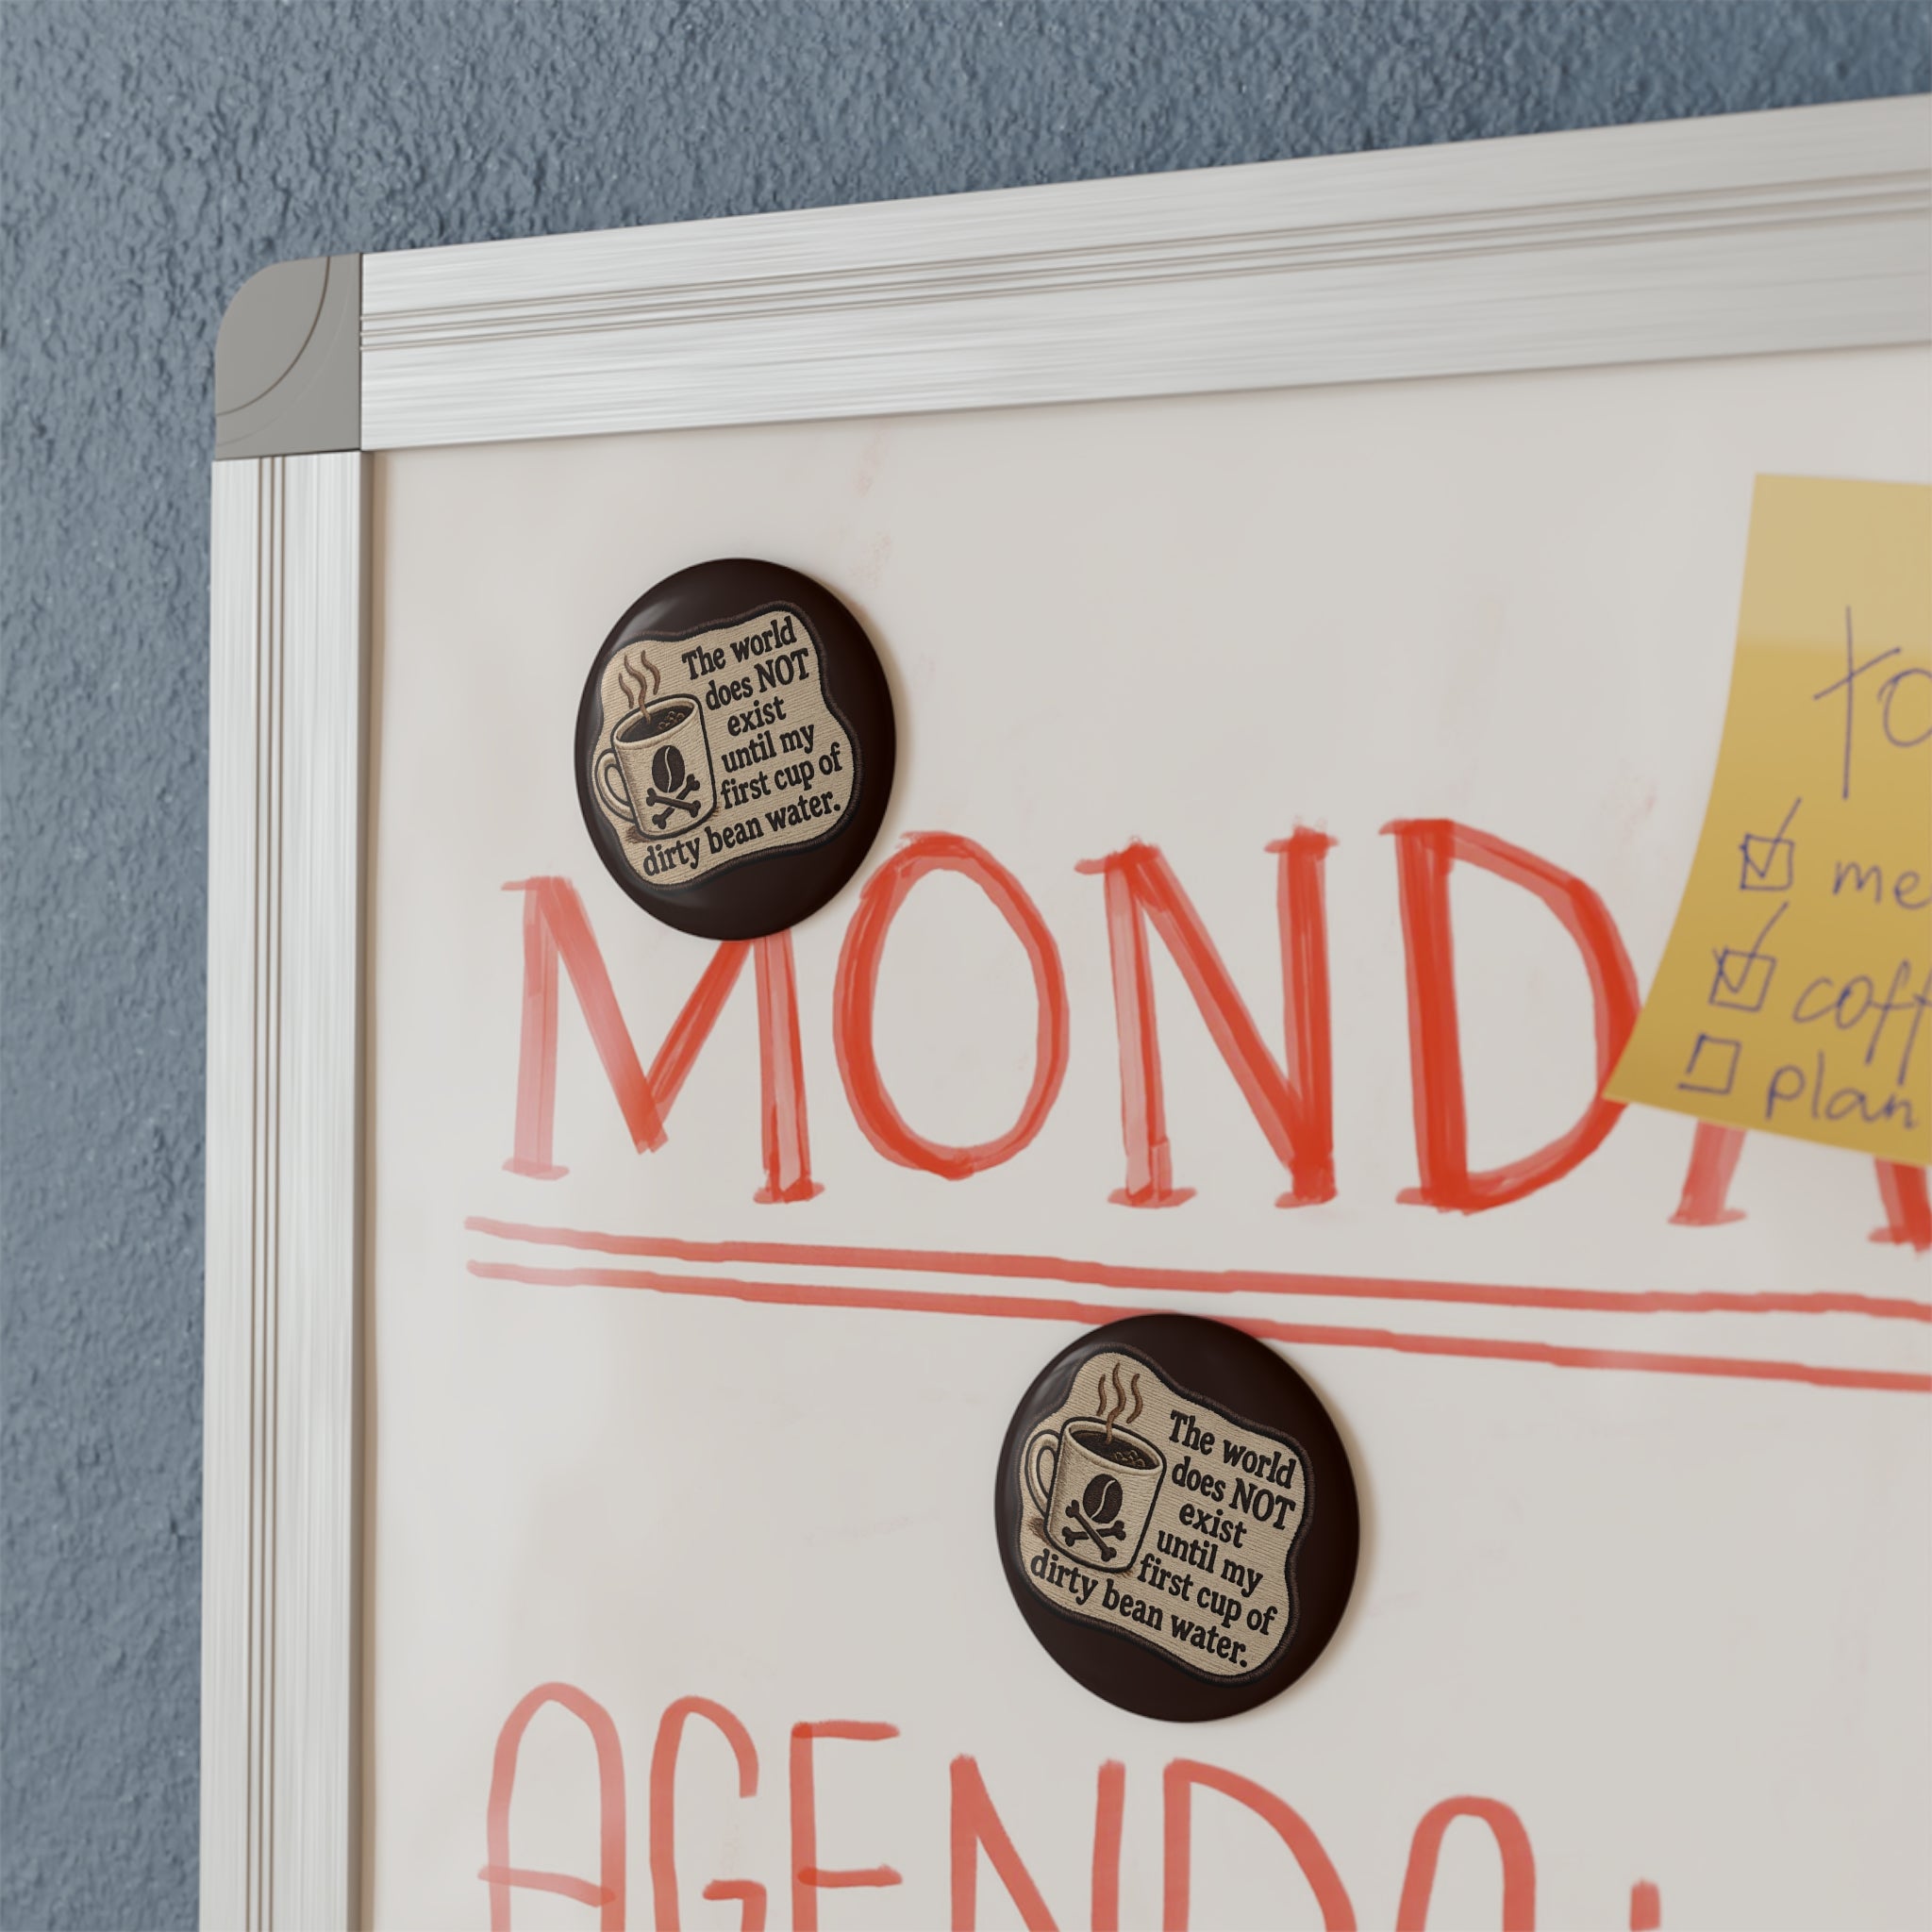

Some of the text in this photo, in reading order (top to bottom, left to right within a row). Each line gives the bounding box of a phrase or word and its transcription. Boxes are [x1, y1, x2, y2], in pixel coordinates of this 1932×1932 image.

[682, 616, 797, 681] The world
[706, 648, 808, 711] does NOT
[727, 695, 786, 736] exist
[1813, 605, 1932, 800] to
[721, 741, 842, 809] first cup of
[722, 724, 814, 774] until my
[642, 791, 841, 877] dirty bean water.
[1832, 860, 1932, 910] me
[502, 817, 1932, 1251] MOND
[1767, 1050, 1920, 1129] plan
[1169, 1410, 1297, 1490] The world
[1172, 1456, 1296, 1530] does NOT
[1178, 1498, 1247, 1549] exist
[1138, 1553, 1277, 1636] first cup of
[1157, 1530, 1263, 1598] until my
[1030, 1548, 1249, 1668] dirty bean water.
